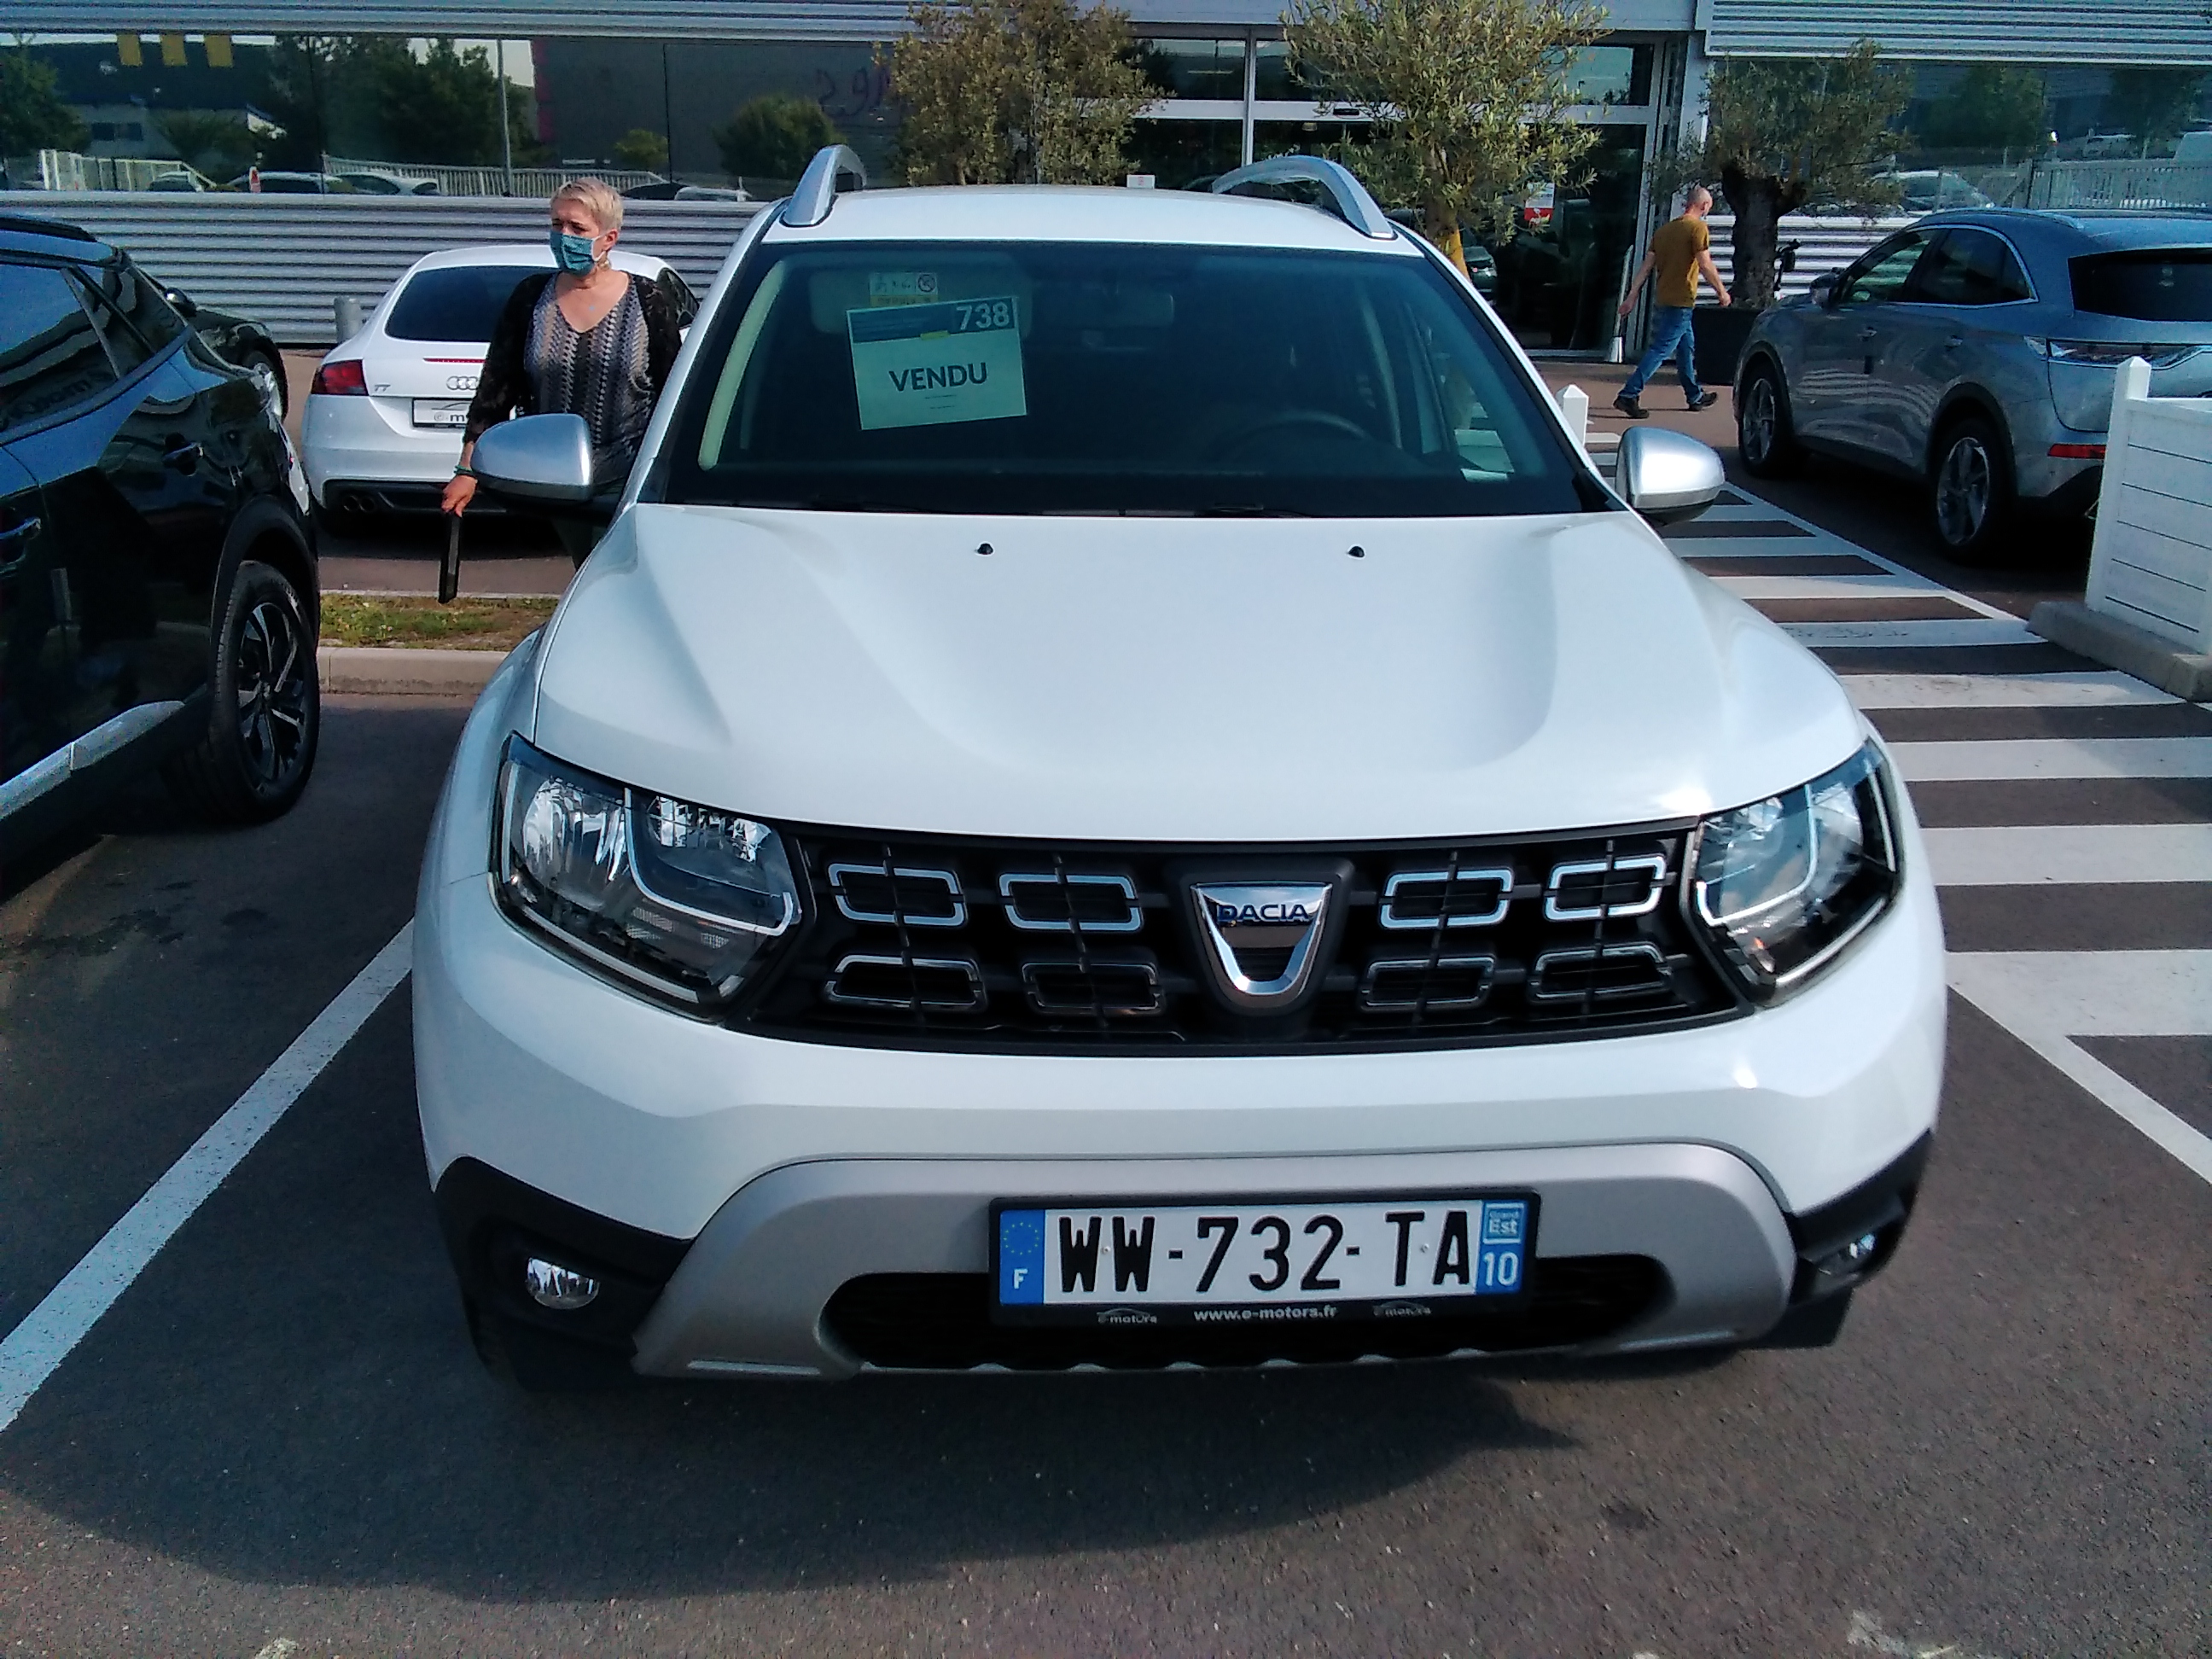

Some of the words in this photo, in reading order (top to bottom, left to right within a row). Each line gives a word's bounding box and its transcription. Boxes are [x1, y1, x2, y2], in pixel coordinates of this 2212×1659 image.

[956, 301, 1010, 330] 738
[888, 362, 988, 392] VENDU
[1218, 903, 1309, 923] DACIA
[1489, 1219, 1517, 1235] Est
[1014, 1268, 1028, 1289] F
[1483, 1251, 1519, 1287] 10
[1193, 1304, 1337, 1320] www.e-motors.fr
